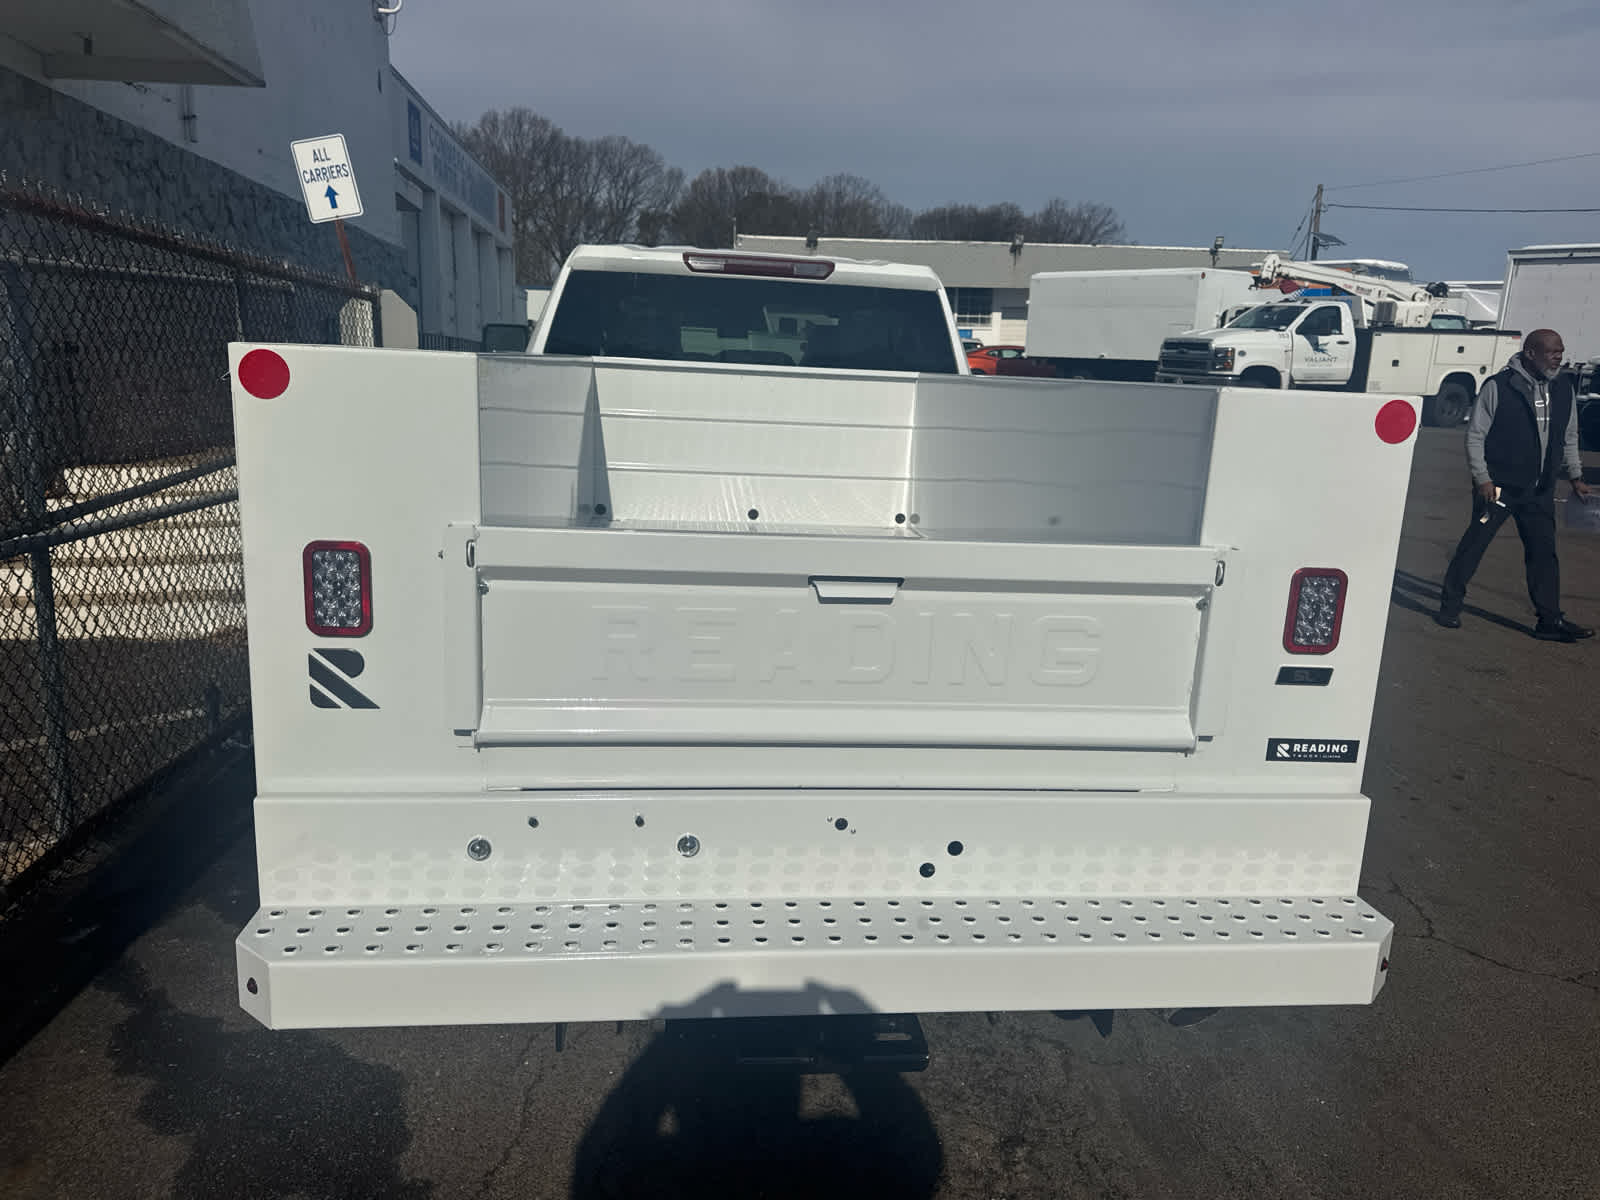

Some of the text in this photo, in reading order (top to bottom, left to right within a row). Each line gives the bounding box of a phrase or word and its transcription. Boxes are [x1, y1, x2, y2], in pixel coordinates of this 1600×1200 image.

[312, 147, 331, 163] ALL
[302, 163, 349, 184] CARRIERS
[591, 604, 1103, 687] READING
[1293, 743, 1349, 753] READING
